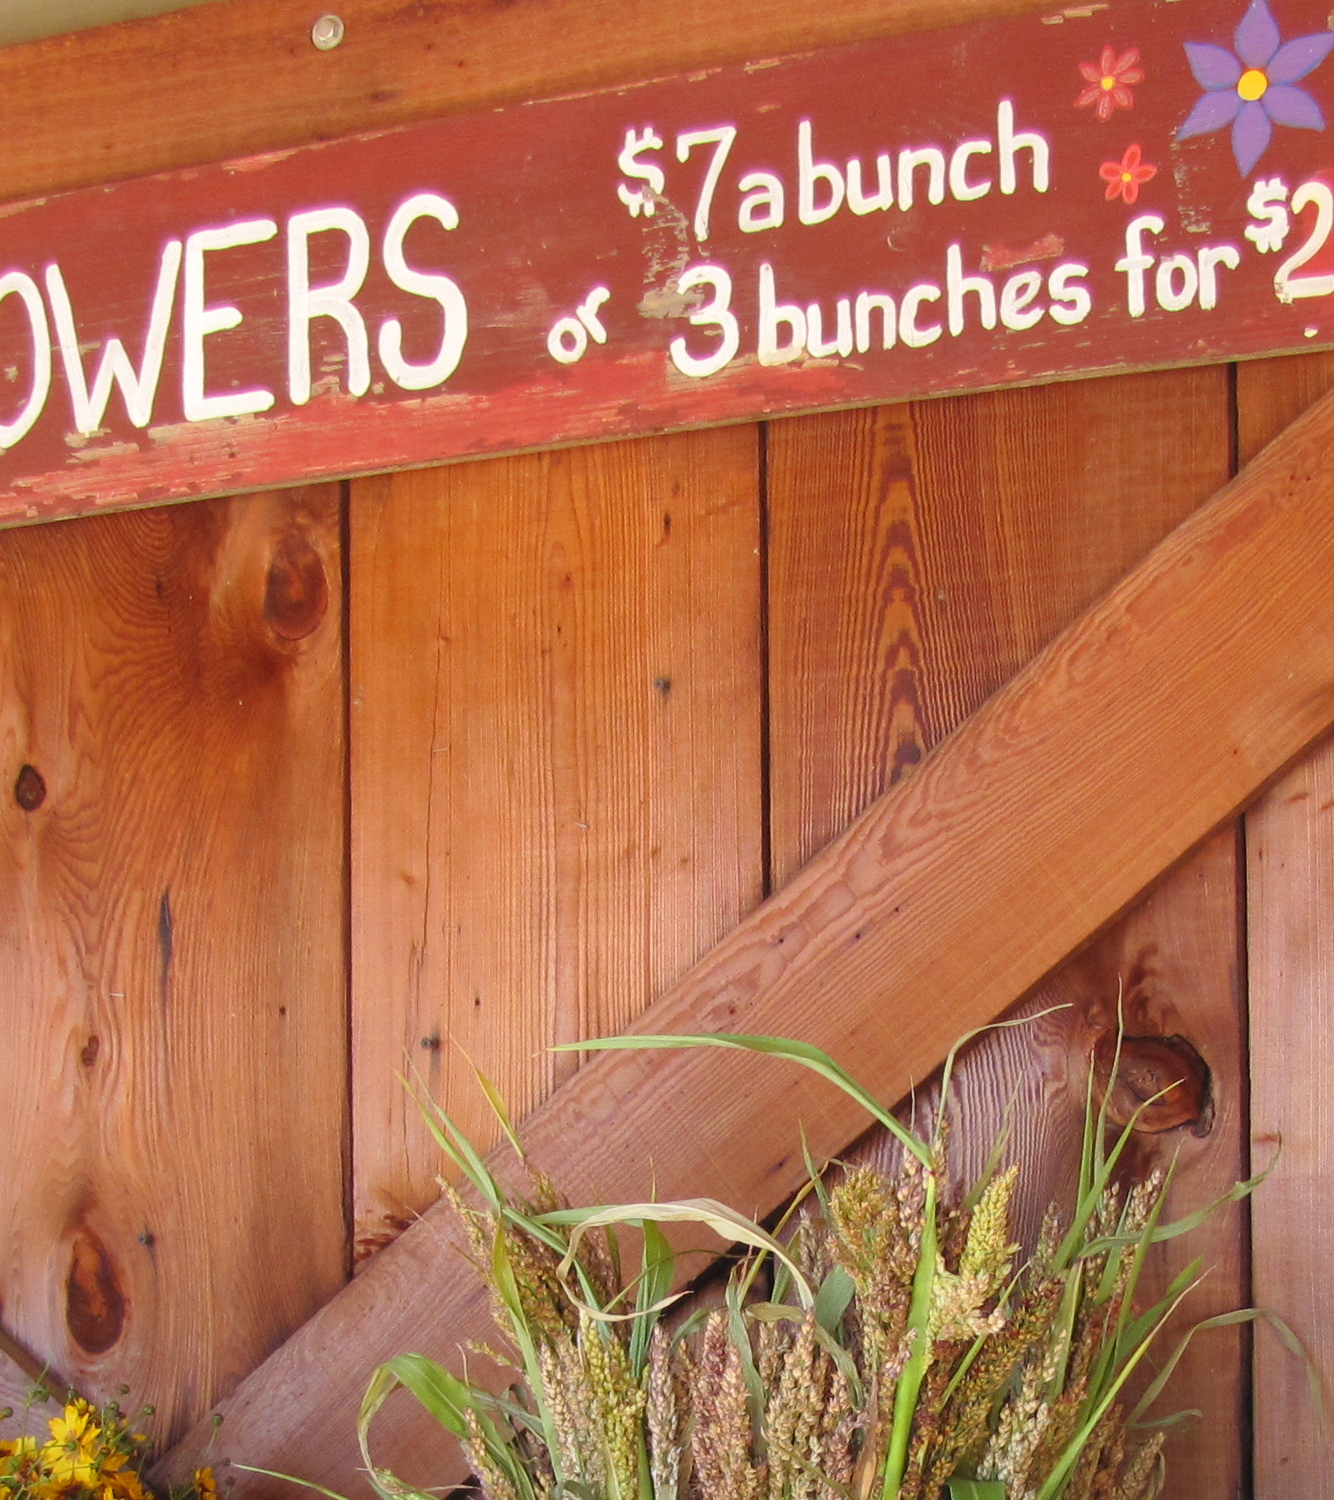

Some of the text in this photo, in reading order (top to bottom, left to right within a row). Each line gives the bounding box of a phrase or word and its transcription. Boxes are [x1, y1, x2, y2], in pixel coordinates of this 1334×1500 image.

[545, 284, 613, 365] or
[668, 262, 741, 379] 3
[756, 242, 1093, 368] bunches
[1113, 214, 1242, 318] for
